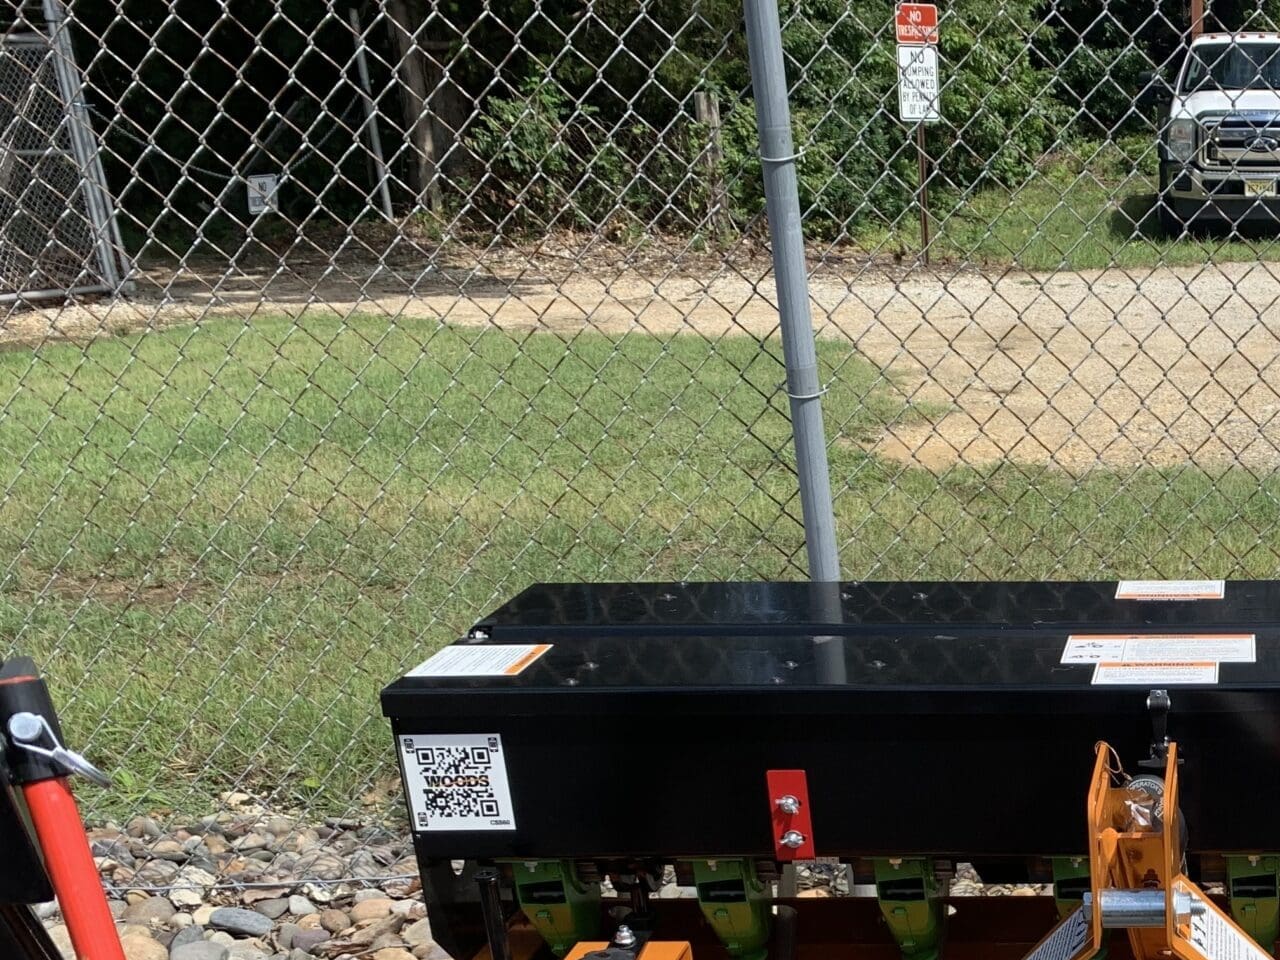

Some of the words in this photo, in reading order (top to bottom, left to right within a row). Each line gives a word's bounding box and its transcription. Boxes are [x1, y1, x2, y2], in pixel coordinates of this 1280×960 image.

[909, 10, 922, 22] NO
[910, 50, 925, 64] NO
[423, 775, 490, 787] WOODS
